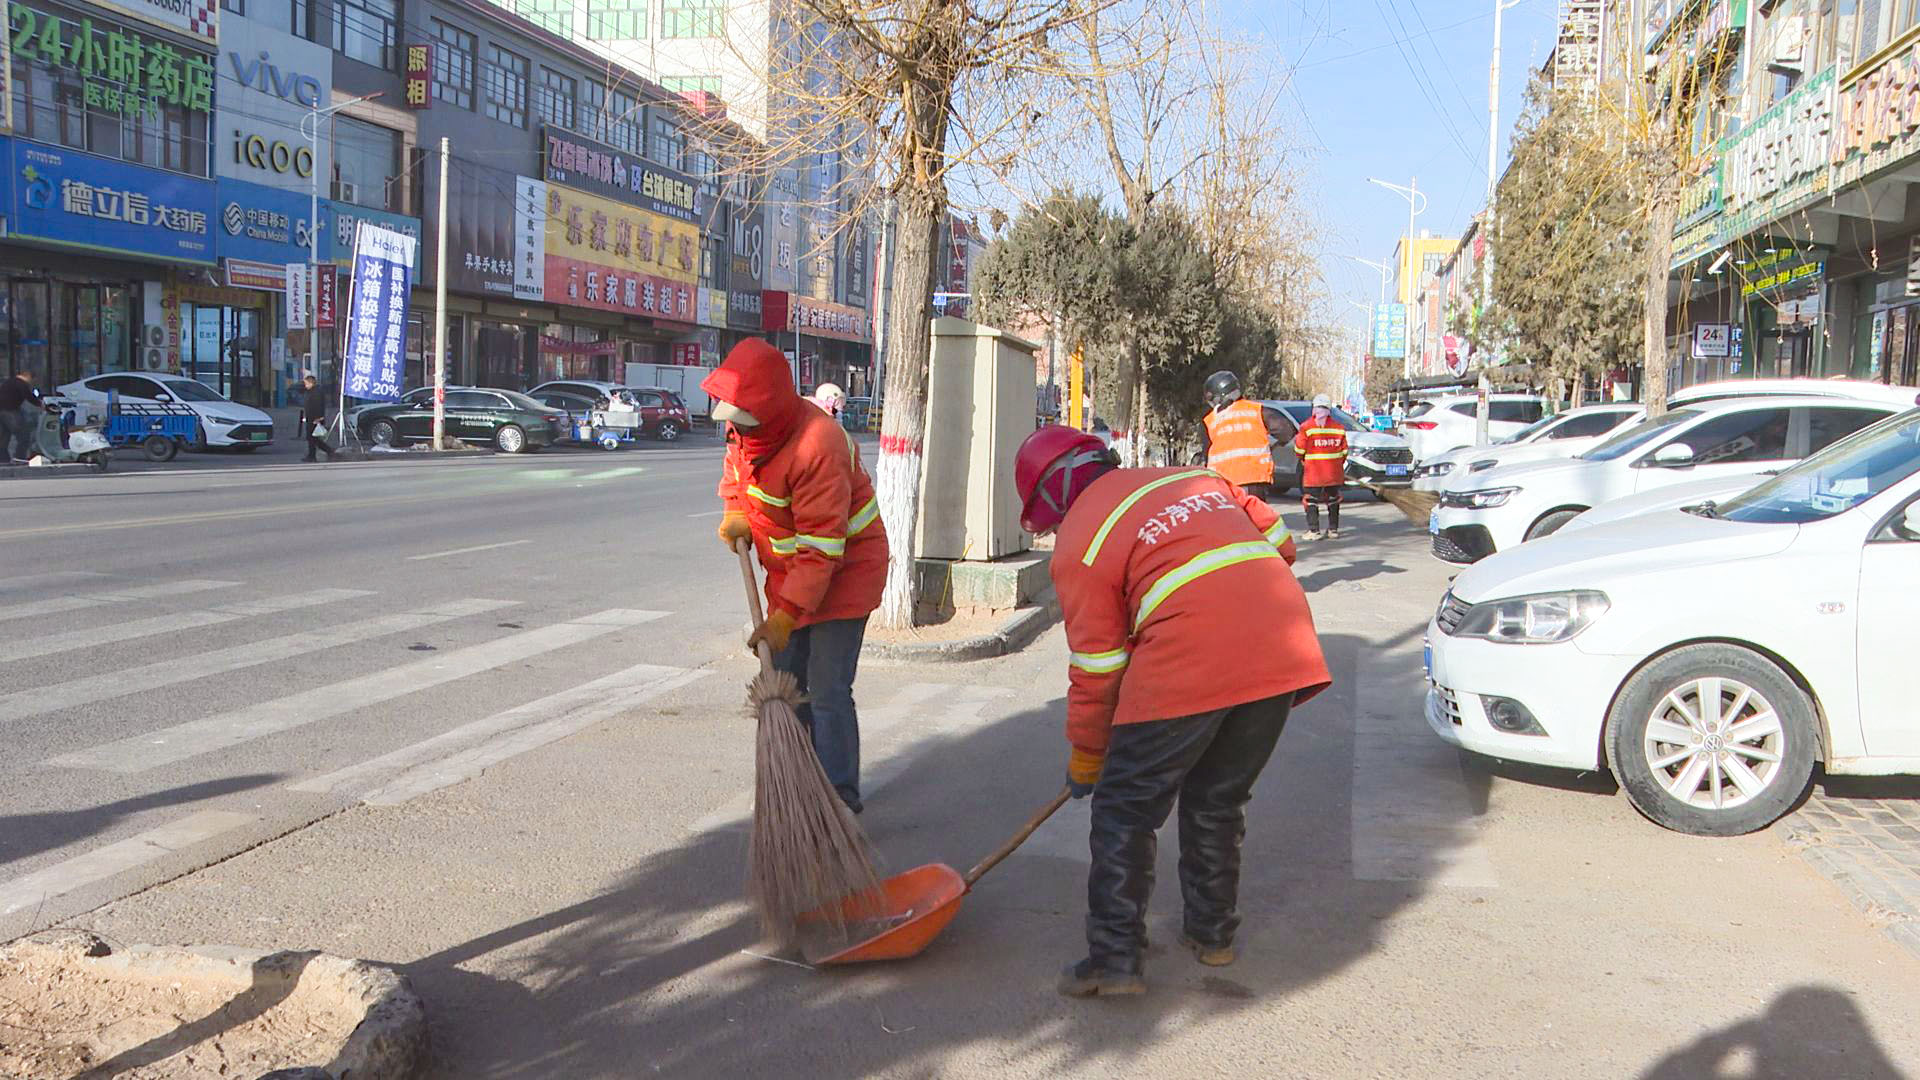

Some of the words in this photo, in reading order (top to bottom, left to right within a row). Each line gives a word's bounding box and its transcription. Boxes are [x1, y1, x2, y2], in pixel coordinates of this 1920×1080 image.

[12, 4, 214, 112] 24小时药店
[229, 51, 322, 107] vivo
[406, 46, 428, 105] 照相
[235, 130, 313, 177] iQOO
[247, 208, 289, 229] 中国移动
[586, 271, 689, 314] 乐家服装超市
[351, 260, 383, 392] 冰箱换新选海尔
[372, 383, 400, 398] 20%
[1138, 491, 1236, 544] 科净环卫
